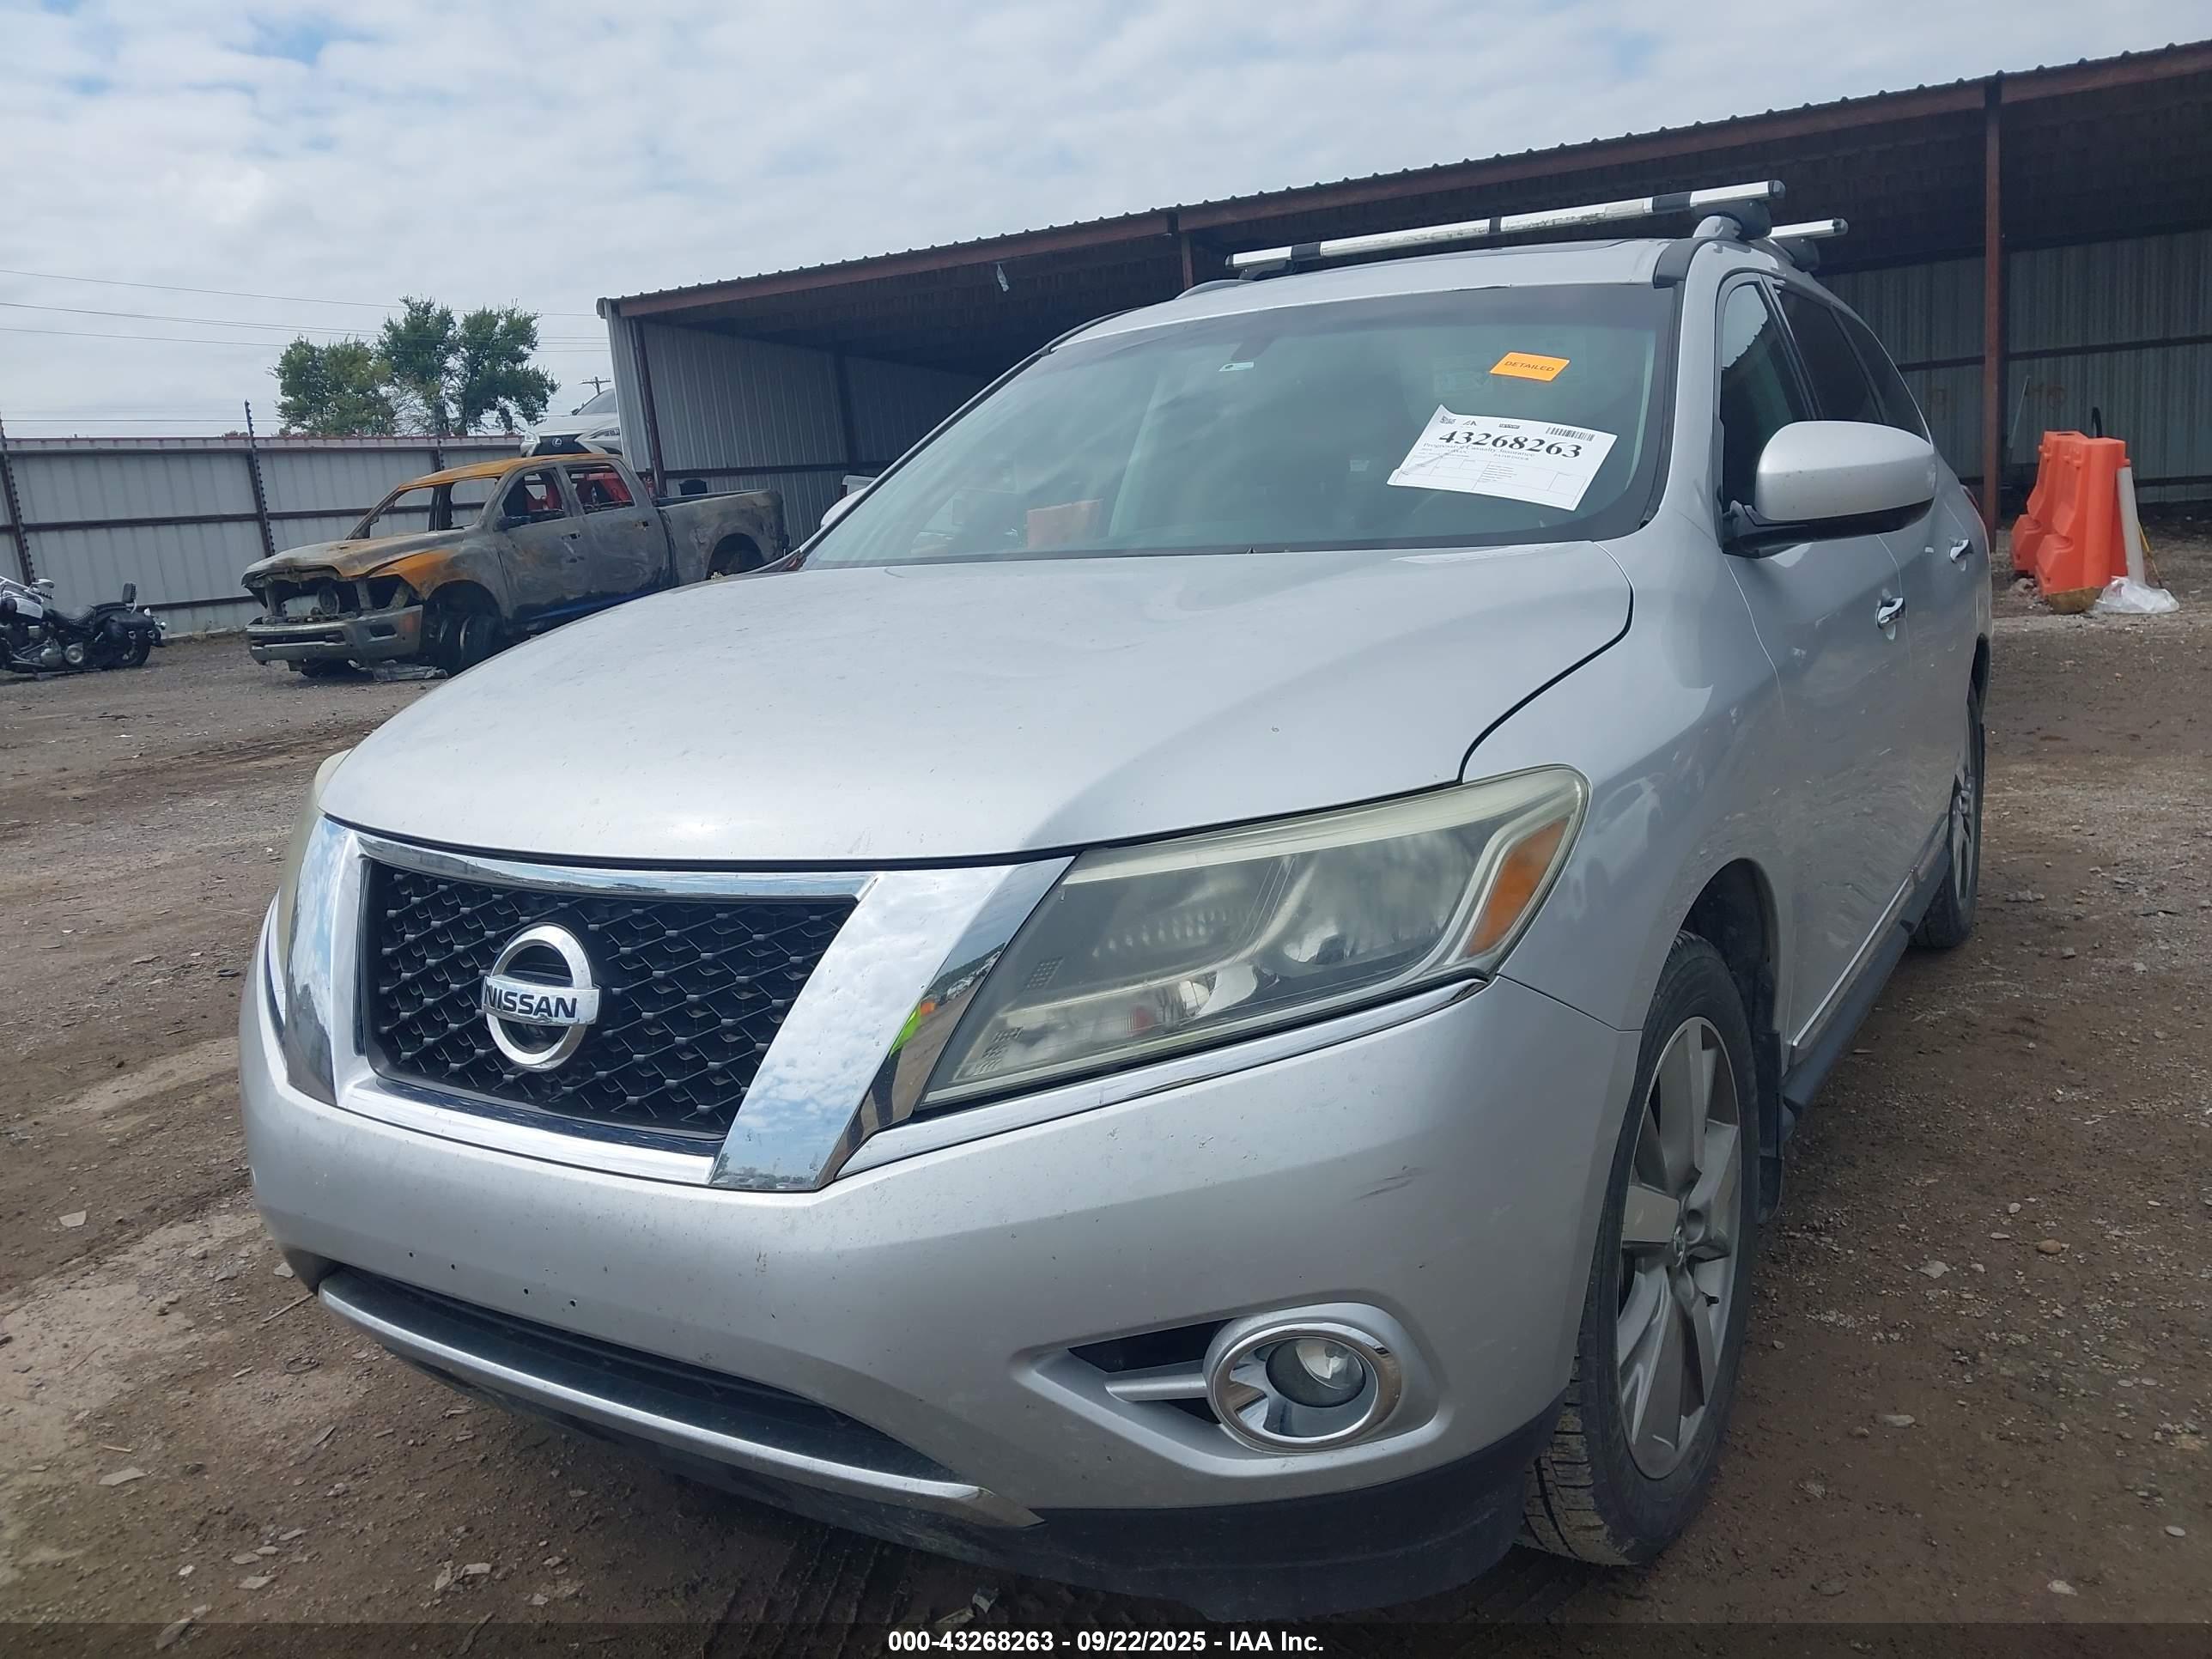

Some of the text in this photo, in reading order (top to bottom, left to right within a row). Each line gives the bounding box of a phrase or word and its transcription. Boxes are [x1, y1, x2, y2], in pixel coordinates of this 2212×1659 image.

[1504, 361, 1554, 372] DETAILED
[1438, 430, 1583, 458] 43268263
[484, 984, 578, 1018] NISSAN
